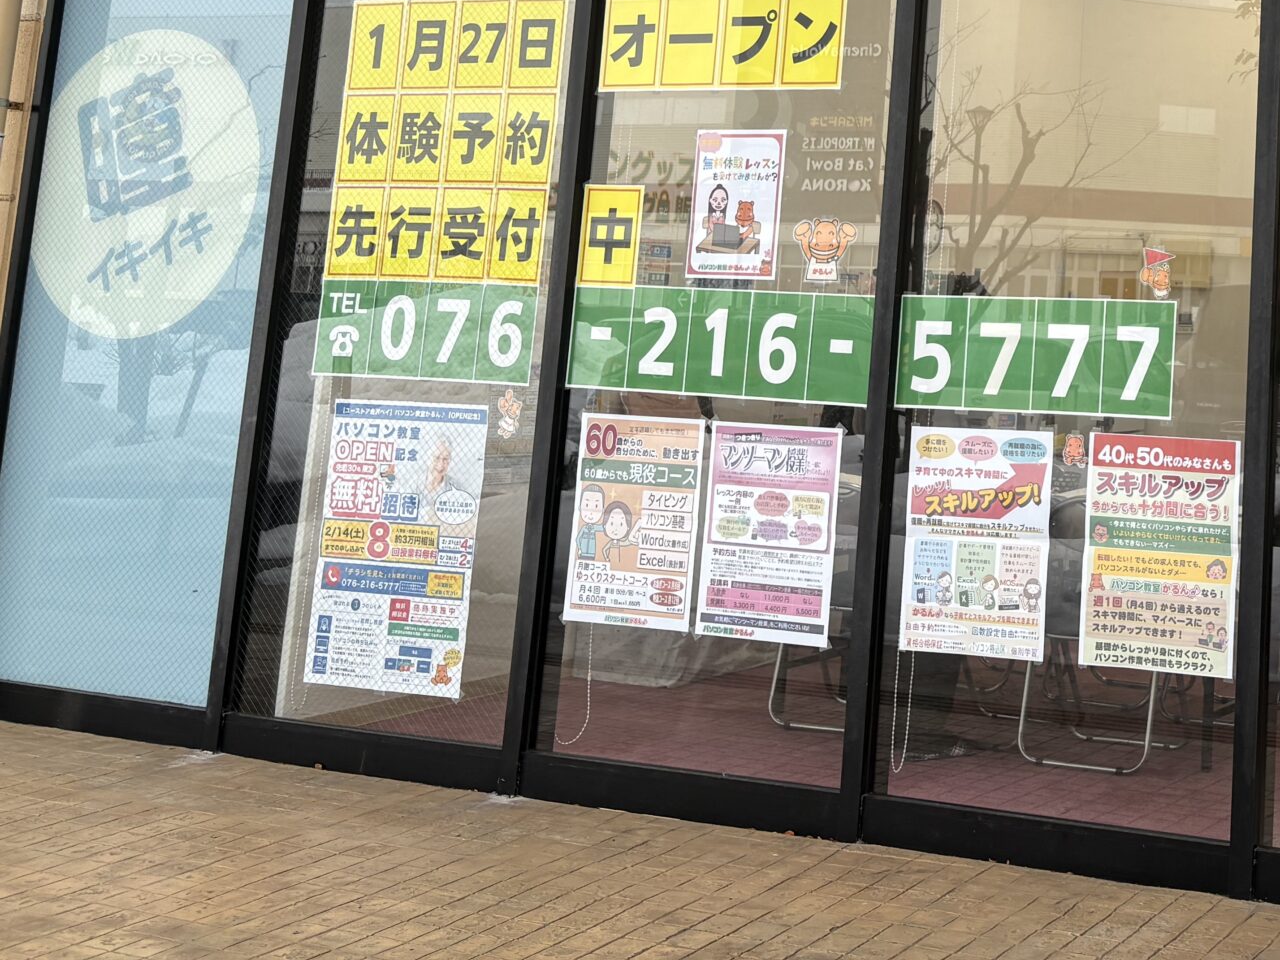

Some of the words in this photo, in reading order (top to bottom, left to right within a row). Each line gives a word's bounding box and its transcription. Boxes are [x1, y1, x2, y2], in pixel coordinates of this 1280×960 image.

[368, 18, 558, 72] 1月27日
[610, 9, 838, 67] オープン
[345, 110, 551, 167] 体験予約
[334, 205, 540, 264] 先行受付
[590, 207, 634, 265] 中
[87, 211, 213, 293] イキイキ
[330, 292, 367, 315] TEL
[379, 294, 524, 368] 076
[910, 320, 1160, 401] 5777
[336, 422, 421, 440] パソコン教室
[586, 423, 617, 456] 60
[335, 440, 394, 462] OPEN
[395, 448, 419, 461] 記念
[965, 440, 993, 448] スムーズに
[662, 447, 700, 461] 動き出す
[584, 463, 696, 486] 60歳からでも現役コース
[915, 466, 1008, 480] 子育て中のスキマ時間に
[716, 489, 754, 498] レッスン内容の
[1096, 471, 1229, 501] スキルアップ
[330, 477, 384, 513] 無料
[382, 493, 419, 516] 招待
[647, 492, 688, 509] タイピング
[925, 482, 1042, 517] スキルアップ!
[1092, 499, 1229, 520] 今からでも十分間に合う!
[646, 513, 686, 530] パソコン基礎
[324, 526, 365, 539] 2/14(土)
[367, 521, 390, 558] 8
[324, 543, 365, 553] までの申し込みで
[394, 536, 435, 547] 約3万円相当
[391, 547, 438, 559] 回授業料無料
[712, 548, 737, 557] 予約方法
[577, 561, 608, 572] 月謝コース
[341, 580, 399, 591] 076-216-5777
[576, 571, 648, 587] ゆっくりスタートコース
[914, 573, 932, 581] Word
[957, 576, 977, 584] Excel
[579, 584, 601, 595] 月4回
[1111, 578, 1161, 594] パソコン教室
[578, 595, 606, 605] 6,600円
[1092, 610, 1203, 628] スキマ時間に、マイペースに
[1092, 623, 1183, 640] スキルアップできます!
[1095, 641, 1212, 662] 基礎からしっかり身に付くので、
